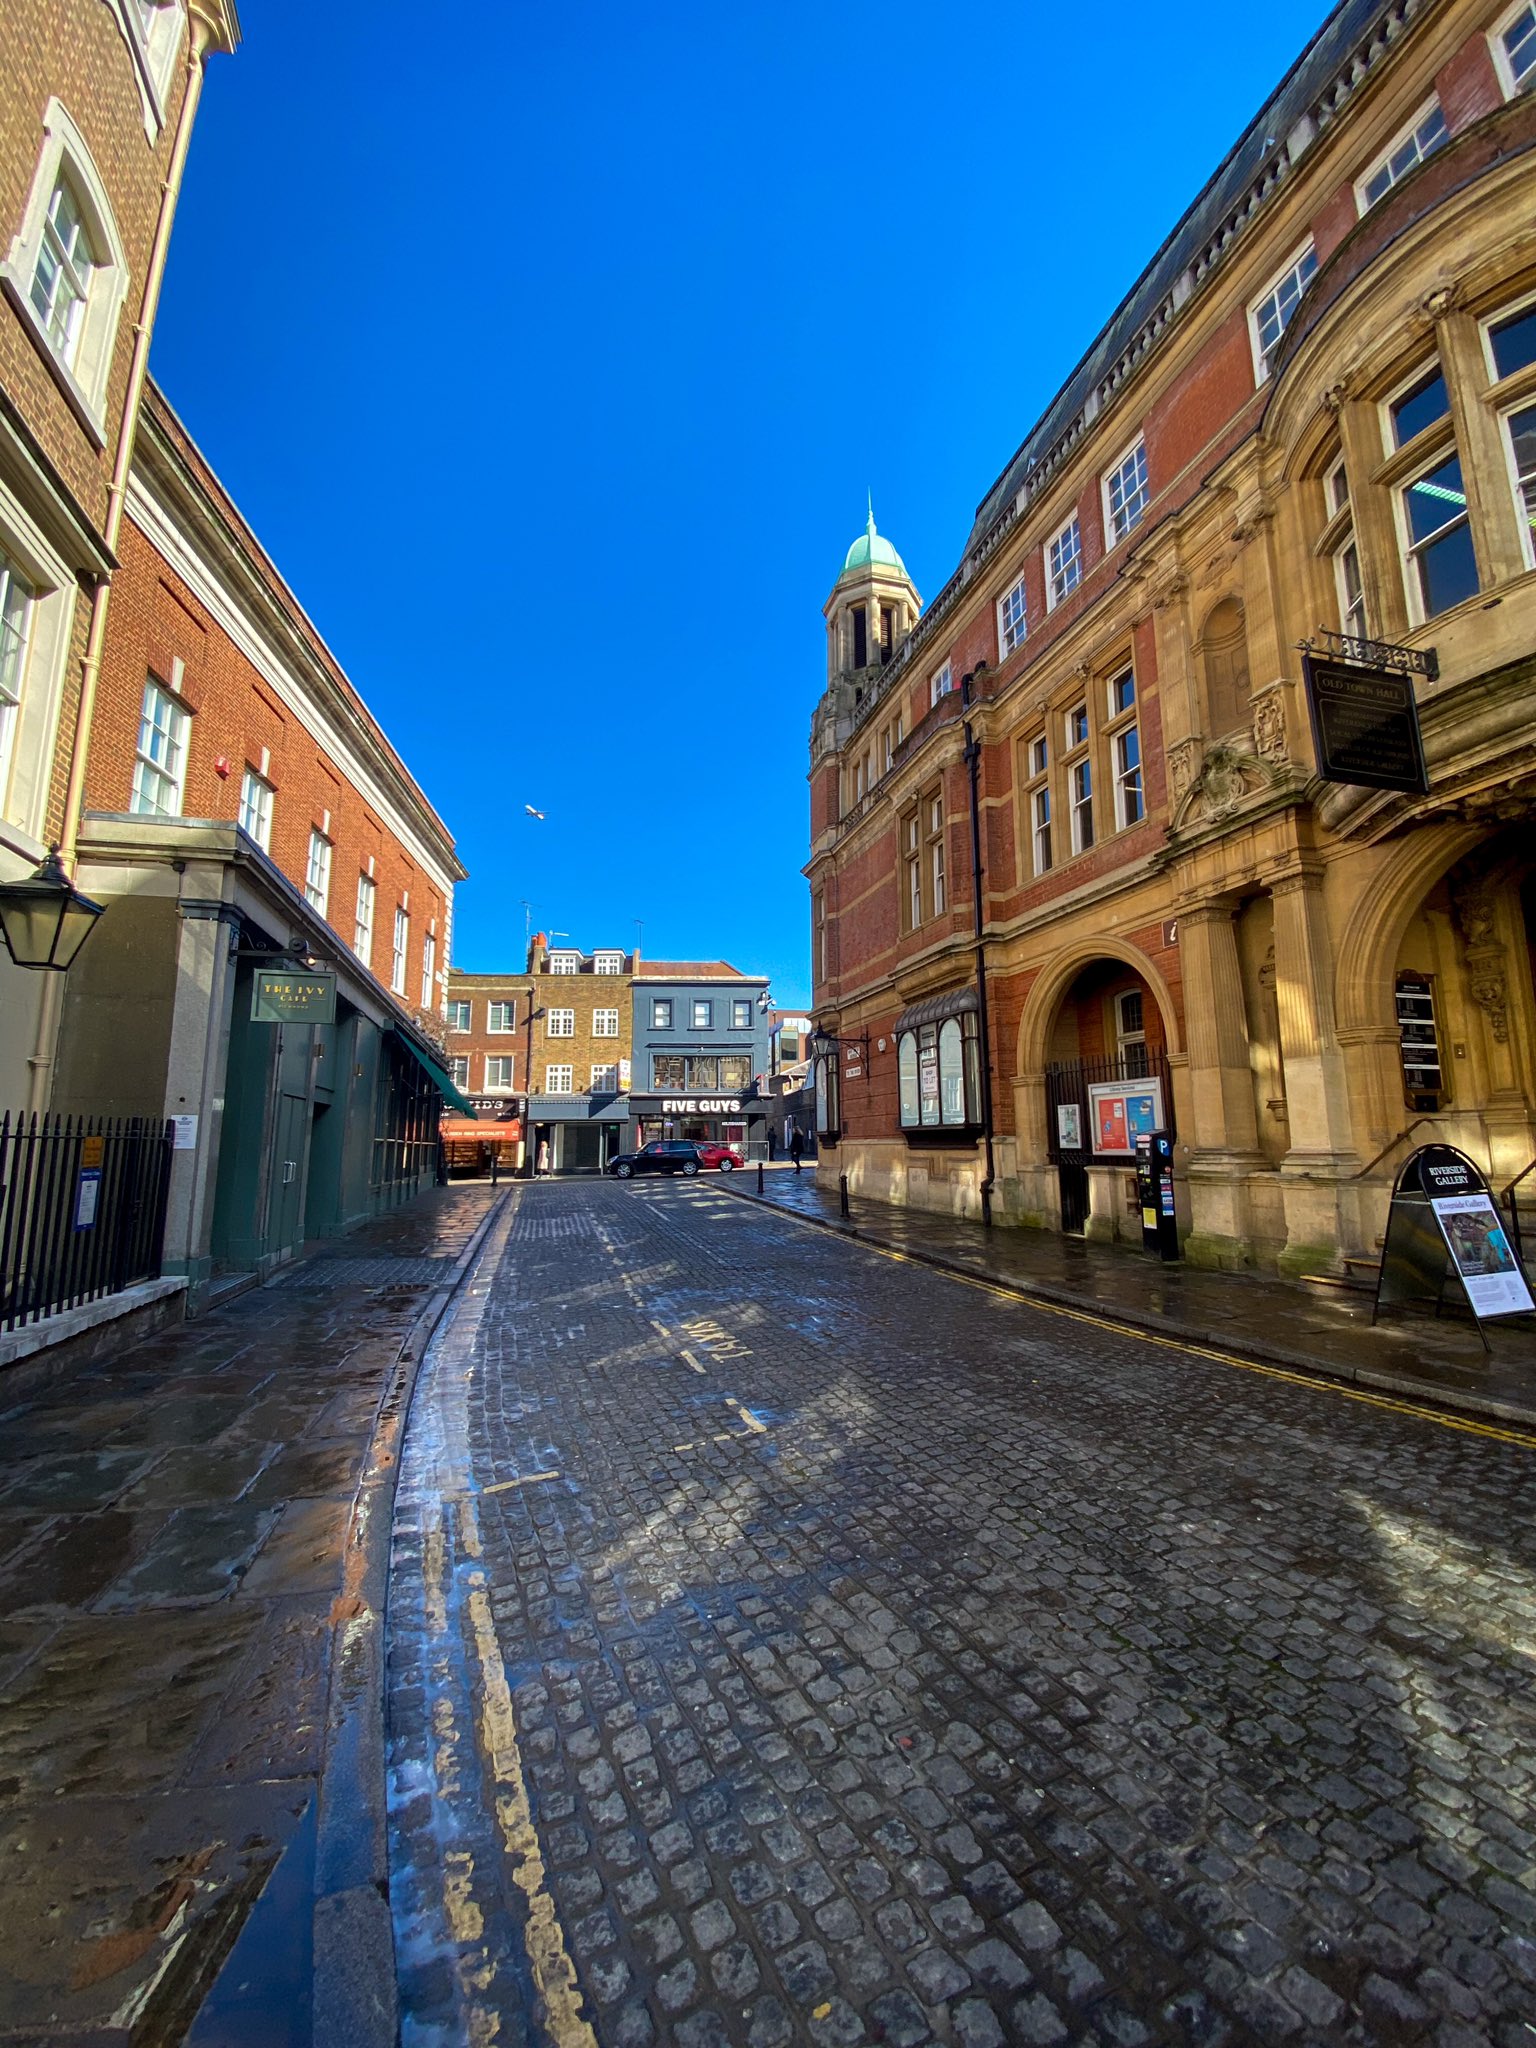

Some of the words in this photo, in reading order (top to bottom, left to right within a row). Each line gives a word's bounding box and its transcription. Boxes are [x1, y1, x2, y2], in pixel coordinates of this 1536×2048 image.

[1322, 677, 1343, 689] OLD
[1345, 682, 1374, 695] TOWN
[1376, 688, 1399, 699] HALL
[264, 984, 291, 994] THE
[298, 986, 326, 995] IVY
[662, 1100, 696, 1112] FIVE
[698, 1099, 741, 1112] GUYS
[1428, 1165, 1468, 1176] RIVERSIDE
[1435, 1175, 1470, 1186] GALLERY
[1437, 1200, 1465, 1211] Riverside
[1464, 1199, 1487, 1210] Gallery
